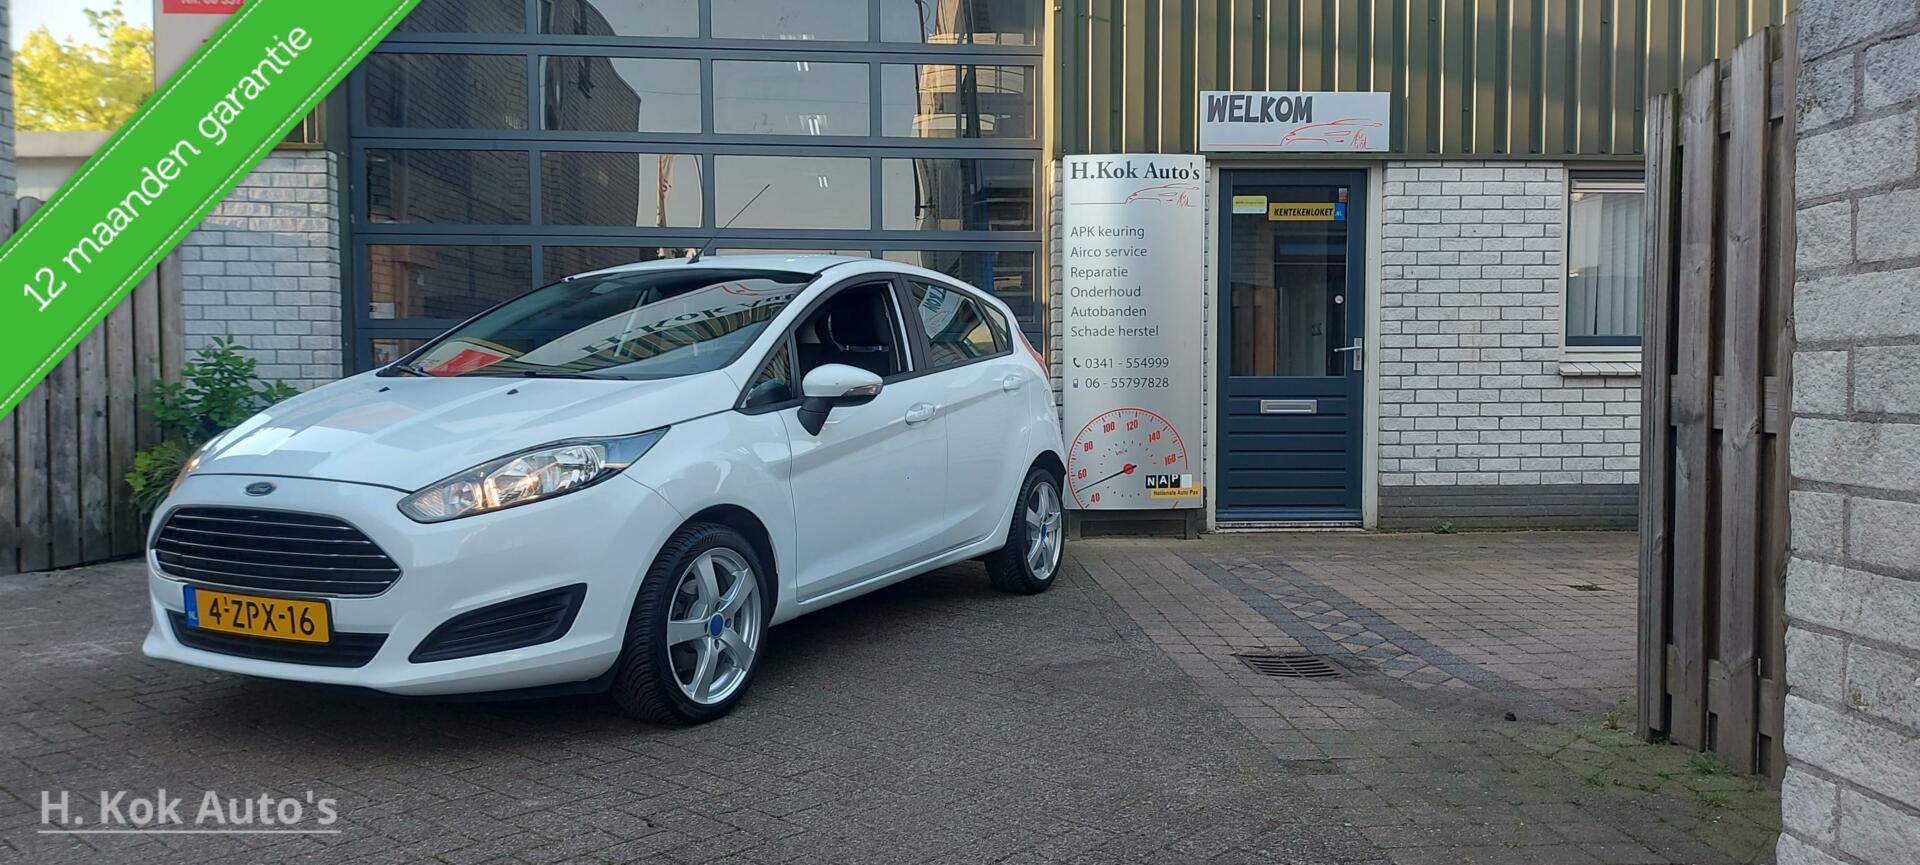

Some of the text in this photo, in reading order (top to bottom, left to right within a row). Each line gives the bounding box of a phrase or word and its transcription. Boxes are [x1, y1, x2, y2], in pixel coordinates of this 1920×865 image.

[1207, 95, 1313, 123] WELKOM
[1071, 160, 1200, 180] H.Kok Auto's
[1274, 208, 1333, 217] KENTEKENLOKET
[1070, 226, 1145, 239] APK keuring
[1070, 246, 1148, 257] Airco service
[1070, 266, 1129, 280] Reparatie
[1070, 285, 1141, 297] Onderhoud
[1070, 305, 1147, 317] Autobanden
[1071, 325, 1159, 337] Schade herstel
[1085, 358, 1113, 368] 0341
[1126, 357, 1169, 368] 554999
[1085, 378, 1100, 388] 06
[1111, 377, 1169, 388] 55797828
[1103, 421, 1115, 433] 100
[1127, 420, 1138, 431] 120
[1149, 431, 1161, 443] 140
[1164, 453, 1176, 465] 160
[1090, 492, 1100, 502] 40
